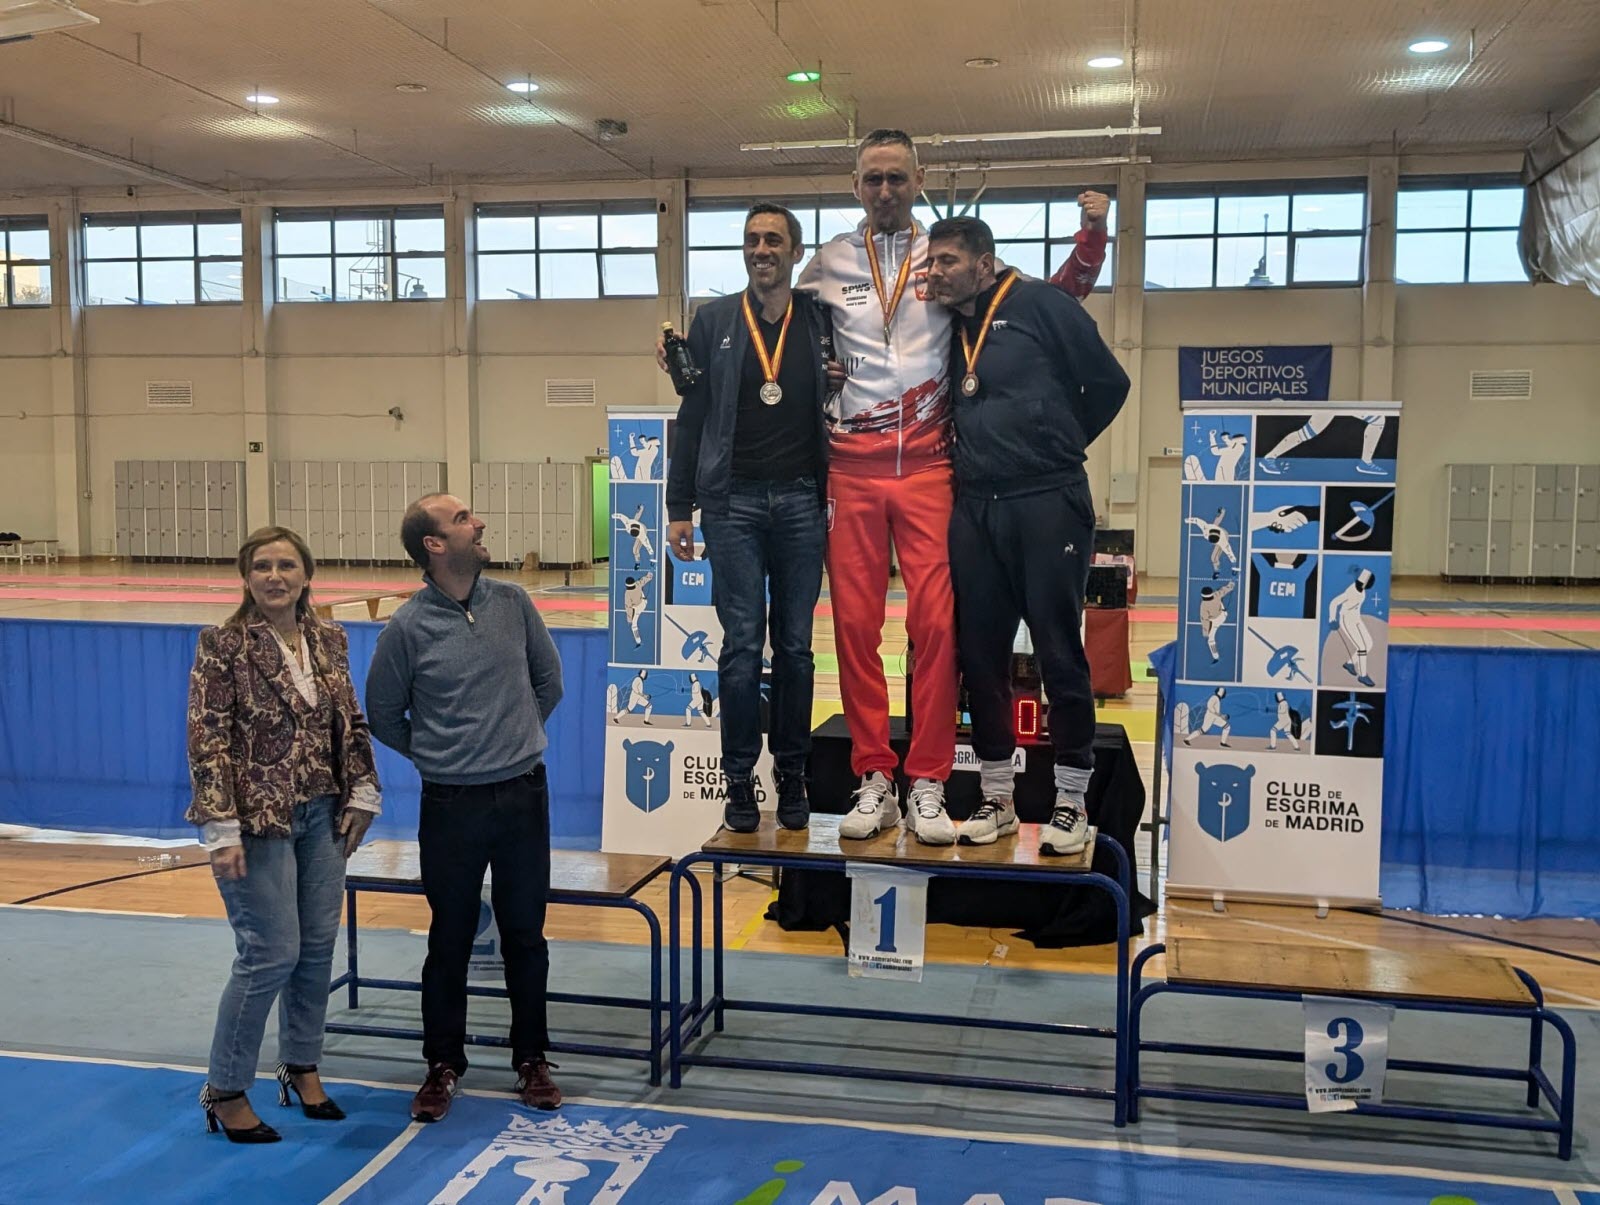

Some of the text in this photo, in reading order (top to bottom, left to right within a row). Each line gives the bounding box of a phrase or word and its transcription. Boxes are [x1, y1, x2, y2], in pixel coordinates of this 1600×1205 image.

[1201, 350, 1264, 367] JUEGOS
[1202, 365, 1304, 379] DEPORTIVOS
[1201, 381, 1308, 395] MUNICIPALES
[682, 571, 704, 586] CEM
[1270, 581, 1296, 597] CEM
[1018, 700, 1037, 735] 0
[683, 791, 695, 799] DE
[1266, 781, 1342, 799] CLUB DE
[1266, 797, 1359, 817] ESGRIMA
[1265, 815, 1364, 833] DE MADRID
[873, 886, 897, 953] 1
[1325, 1017, 1364, 1084] 3
